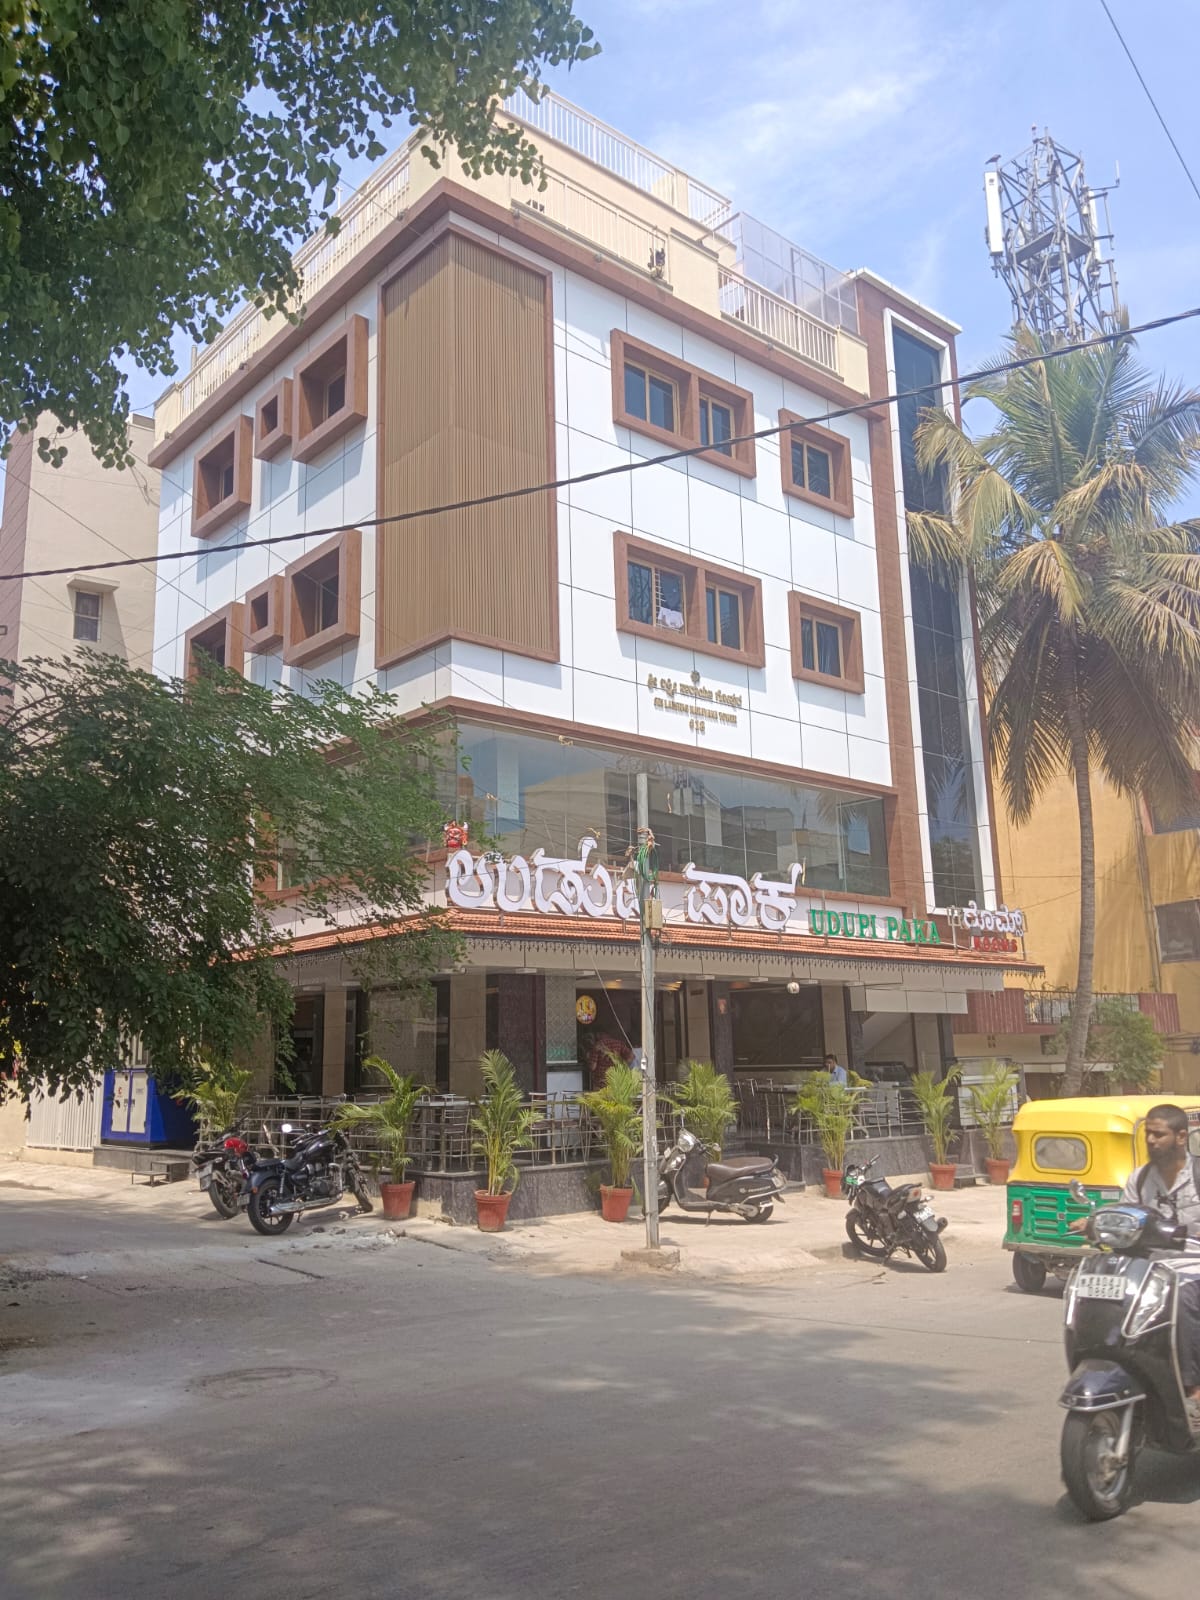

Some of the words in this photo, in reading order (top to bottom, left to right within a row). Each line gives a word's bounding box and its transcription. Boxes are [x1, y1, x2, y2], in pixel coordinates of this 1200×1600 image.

[685, 862, 803, 930] ಪಾಕ
[809, 908, 878, 939] UDUPI
[885, 916, 942, 944] PAKA
[972, 936, 1018, 952] ROOMS
